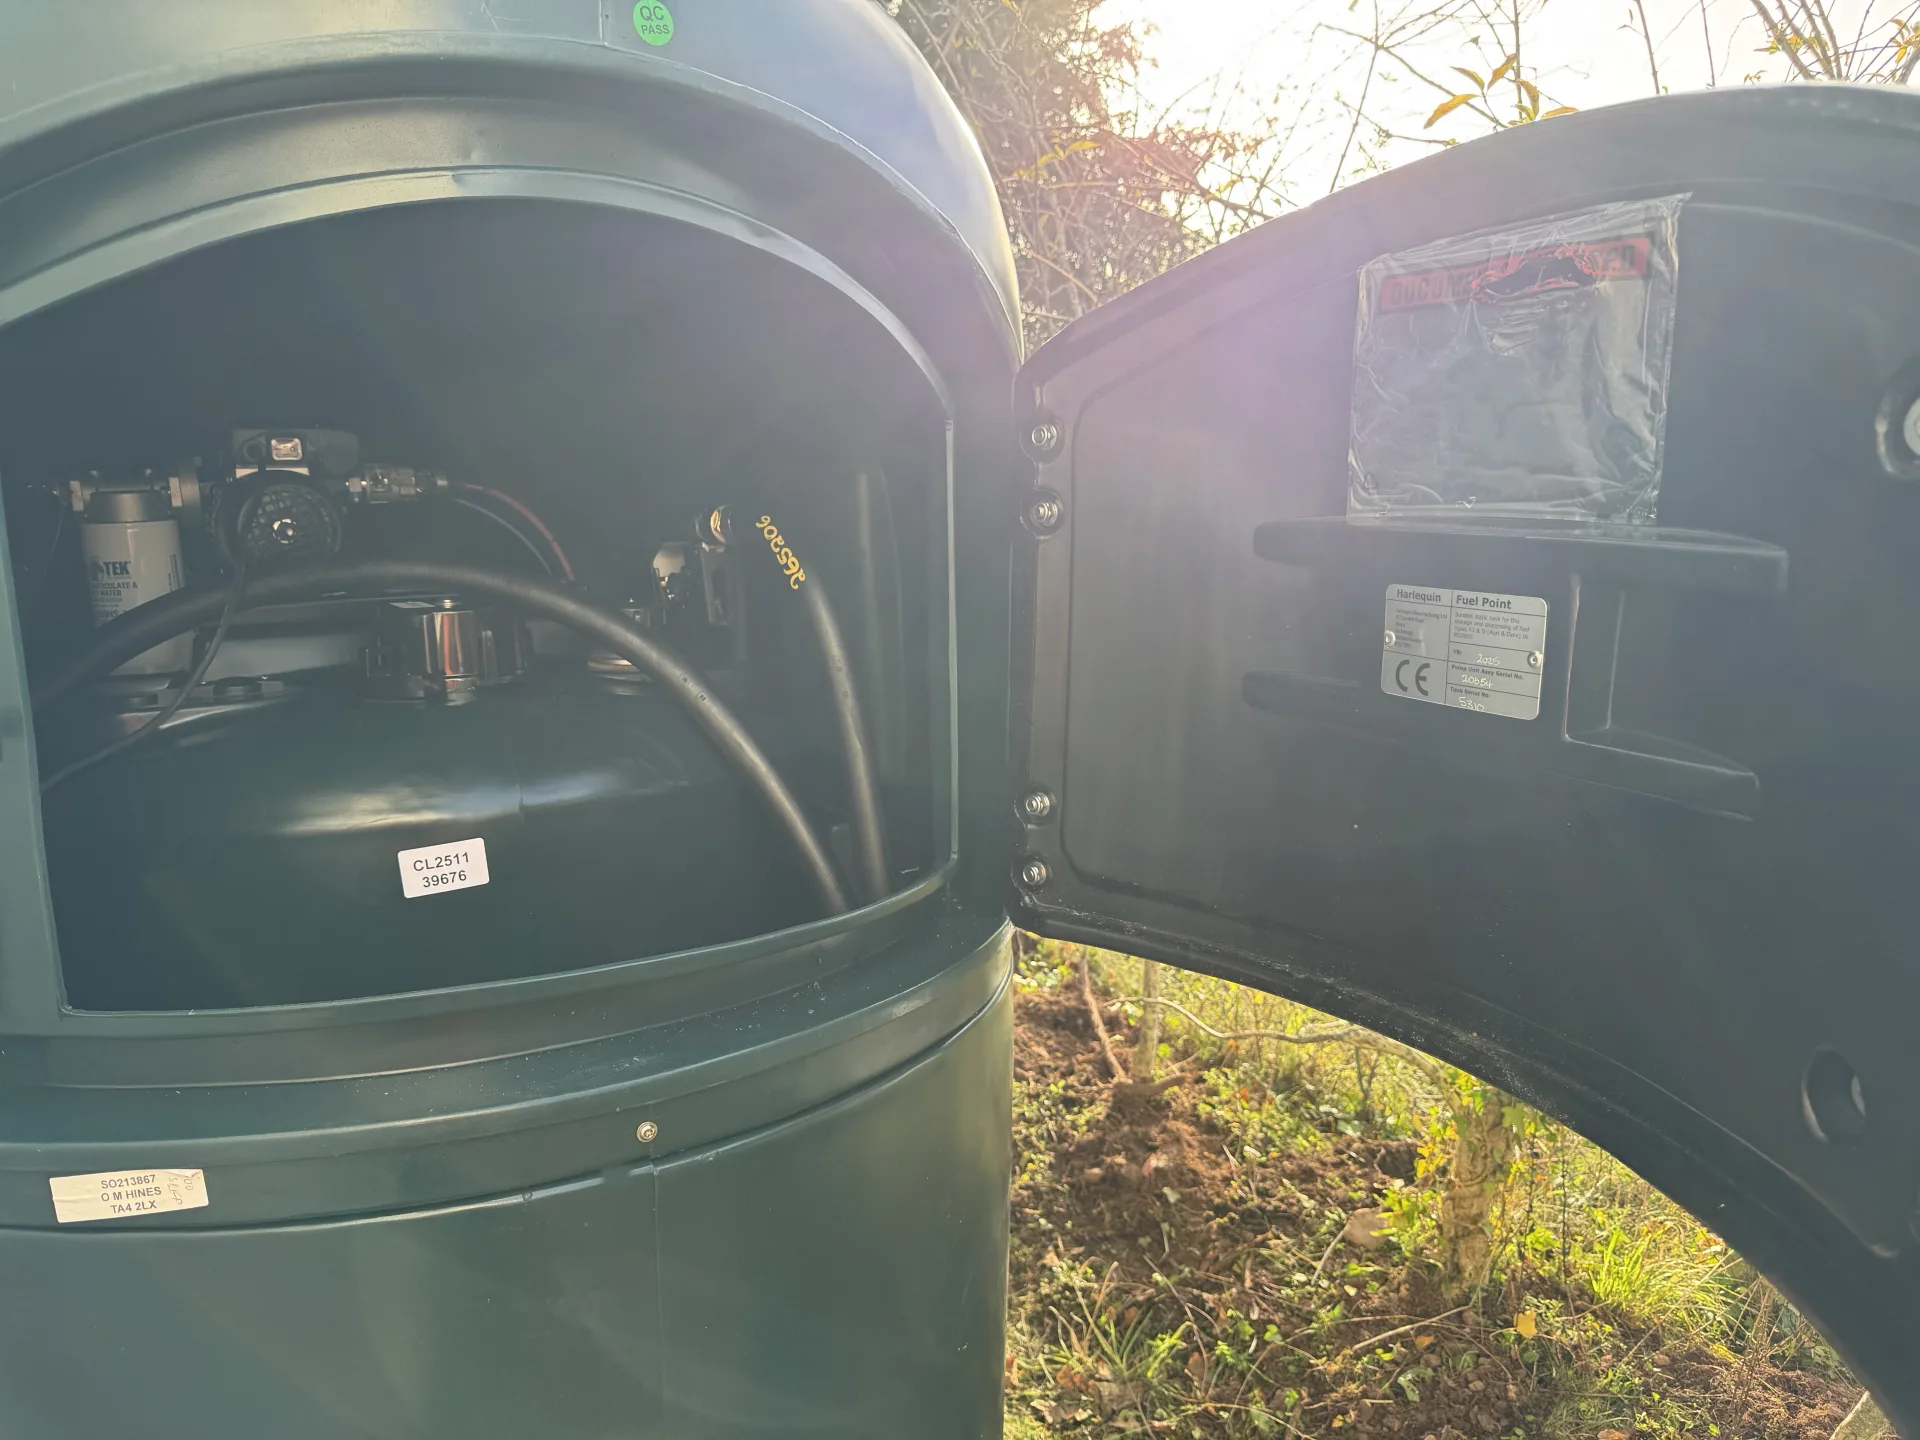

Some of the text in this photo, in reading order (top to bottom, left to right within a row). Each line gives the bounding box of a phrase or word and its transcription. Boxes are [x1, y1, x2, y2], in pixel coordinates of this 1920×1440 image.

[640, 5, 664, 21] QC
[641, 24, 670, 35] PASS
[755, 515, 806, 590] 265206
[1396, 589, 1441, 603] Harlequin
[1456, 594, 1512, 610] Fuel Point
[1476, 654, 1500, 667] 2025
[1395, 659, 1430, 697] CE
[1451, 665, 1524, 680] Pump Unit Assy Serial No.
[1450, 686, 1491, 698] Tank Serial No.
[413, 852, 469, 872] CL2511
[422, 870, 467, 888] 39676
[100, 1174, 156, 1189] SO213867
[101, 1186, 162, 1202] O M HINES
[110, 1200, 158, 1214] TA4 2LX
